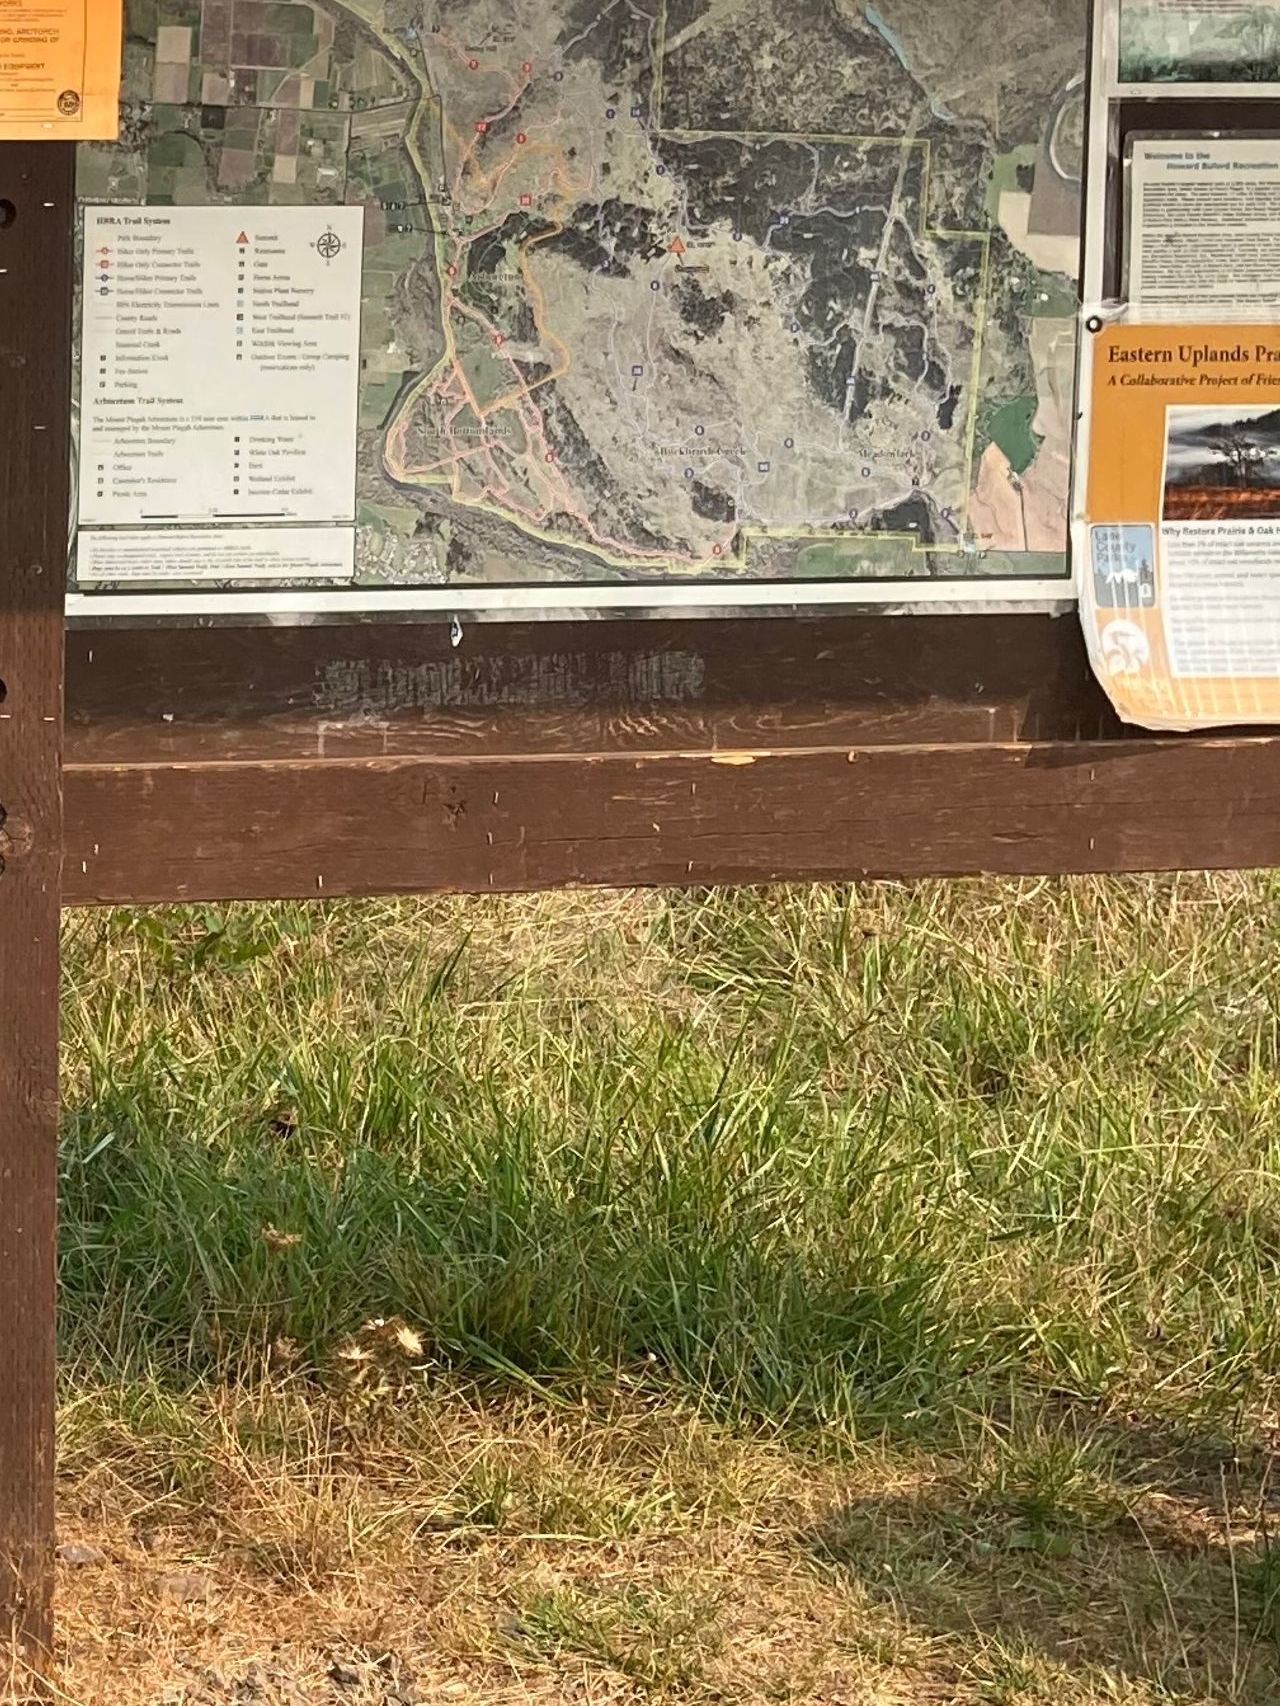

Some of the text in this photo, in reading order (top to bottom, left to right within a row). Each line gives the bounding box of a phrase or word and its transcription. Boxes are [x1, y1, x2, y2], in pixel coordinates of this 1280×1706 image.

[1108, 345, 1171, 363] Eastern
[1179, 344, 1249, 367] Uplands
[1108, 376, 1116, 386] A
[1119, 375, 1197, 386] Collaborative
[1200, 374, 1238, 388] Project
[1241, 373, 1255, 385] of
[1162, 527, 1180, 536] Why
[1183, 527, 1215, 535] Restore
[1217, 527, 1246, 535] Prairie
[1248, 527, 1254, 535] &
[1257, 526, 1274, 535] Oak
